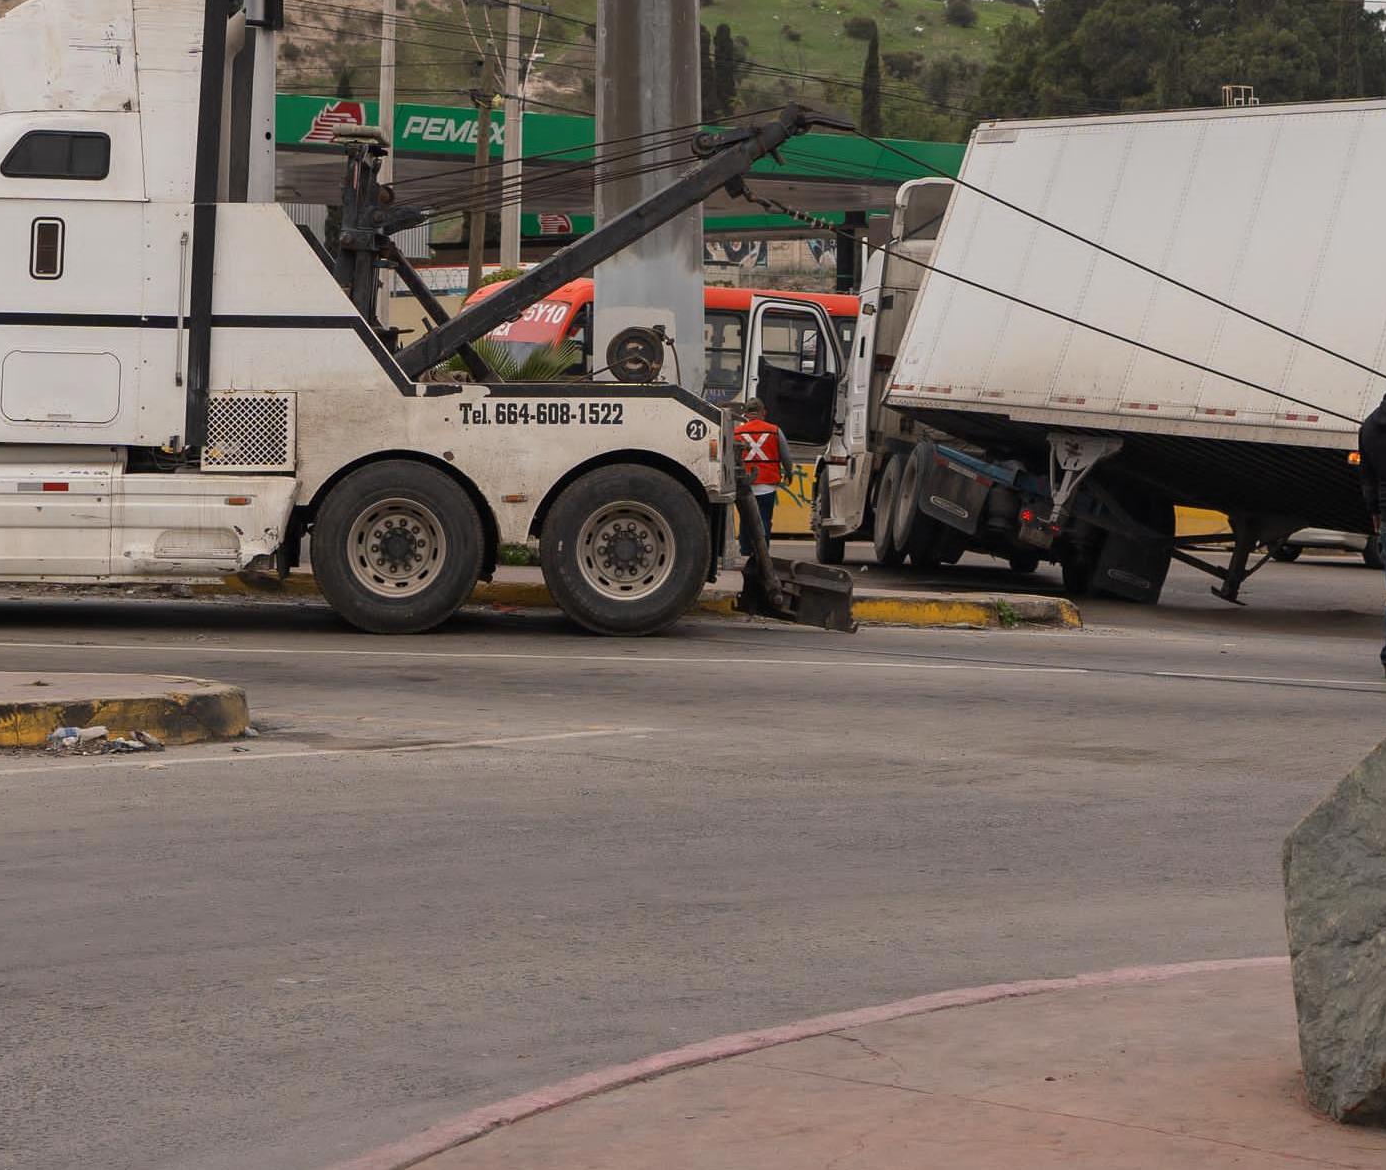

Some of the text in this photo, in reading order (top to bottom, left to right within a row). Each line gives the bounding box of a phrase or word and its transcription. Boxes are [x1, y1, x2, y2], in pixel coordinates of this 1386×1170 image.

[459, 403, 624, 425] Tel. 664-608-1522
[690, 423, 704, 438] 21
